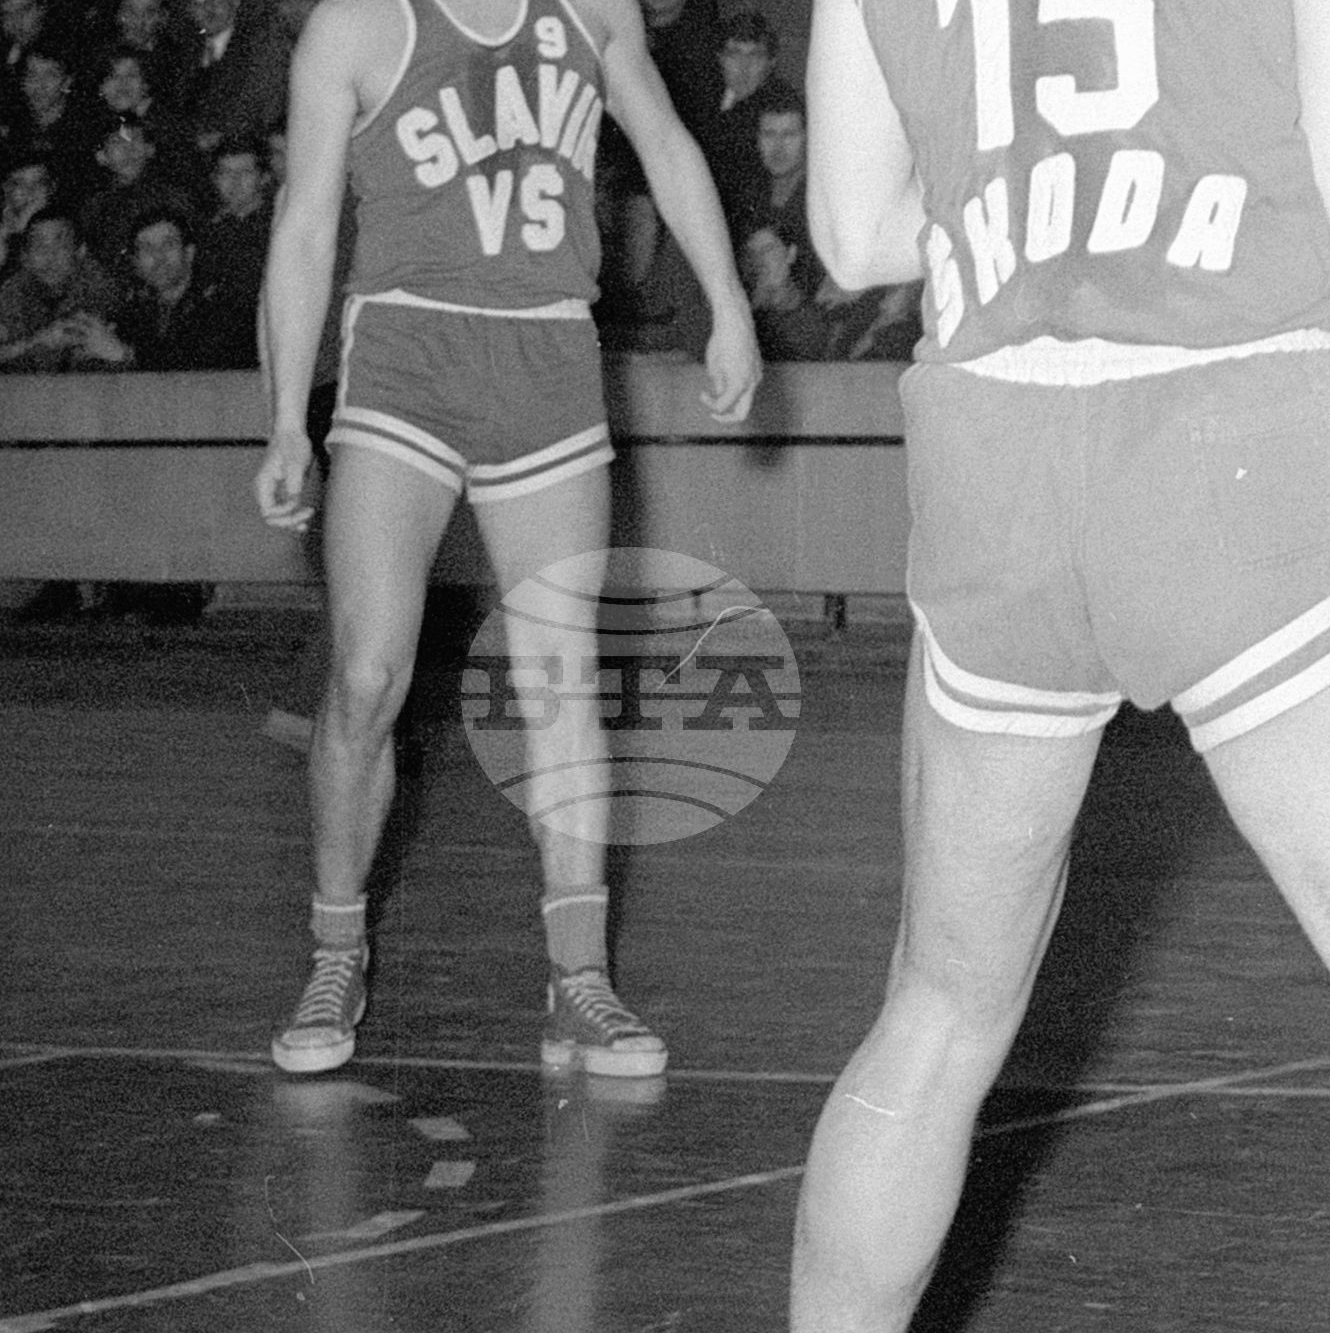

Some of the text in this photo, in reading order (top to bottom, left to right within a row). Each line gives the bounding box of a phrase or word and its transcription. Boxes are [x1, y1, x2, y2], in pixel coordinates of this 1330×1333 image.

[534, 15, 568, 60] 9
[466, 159, 565, 257] VS
[926, 148, 1249, 349] SKODA
